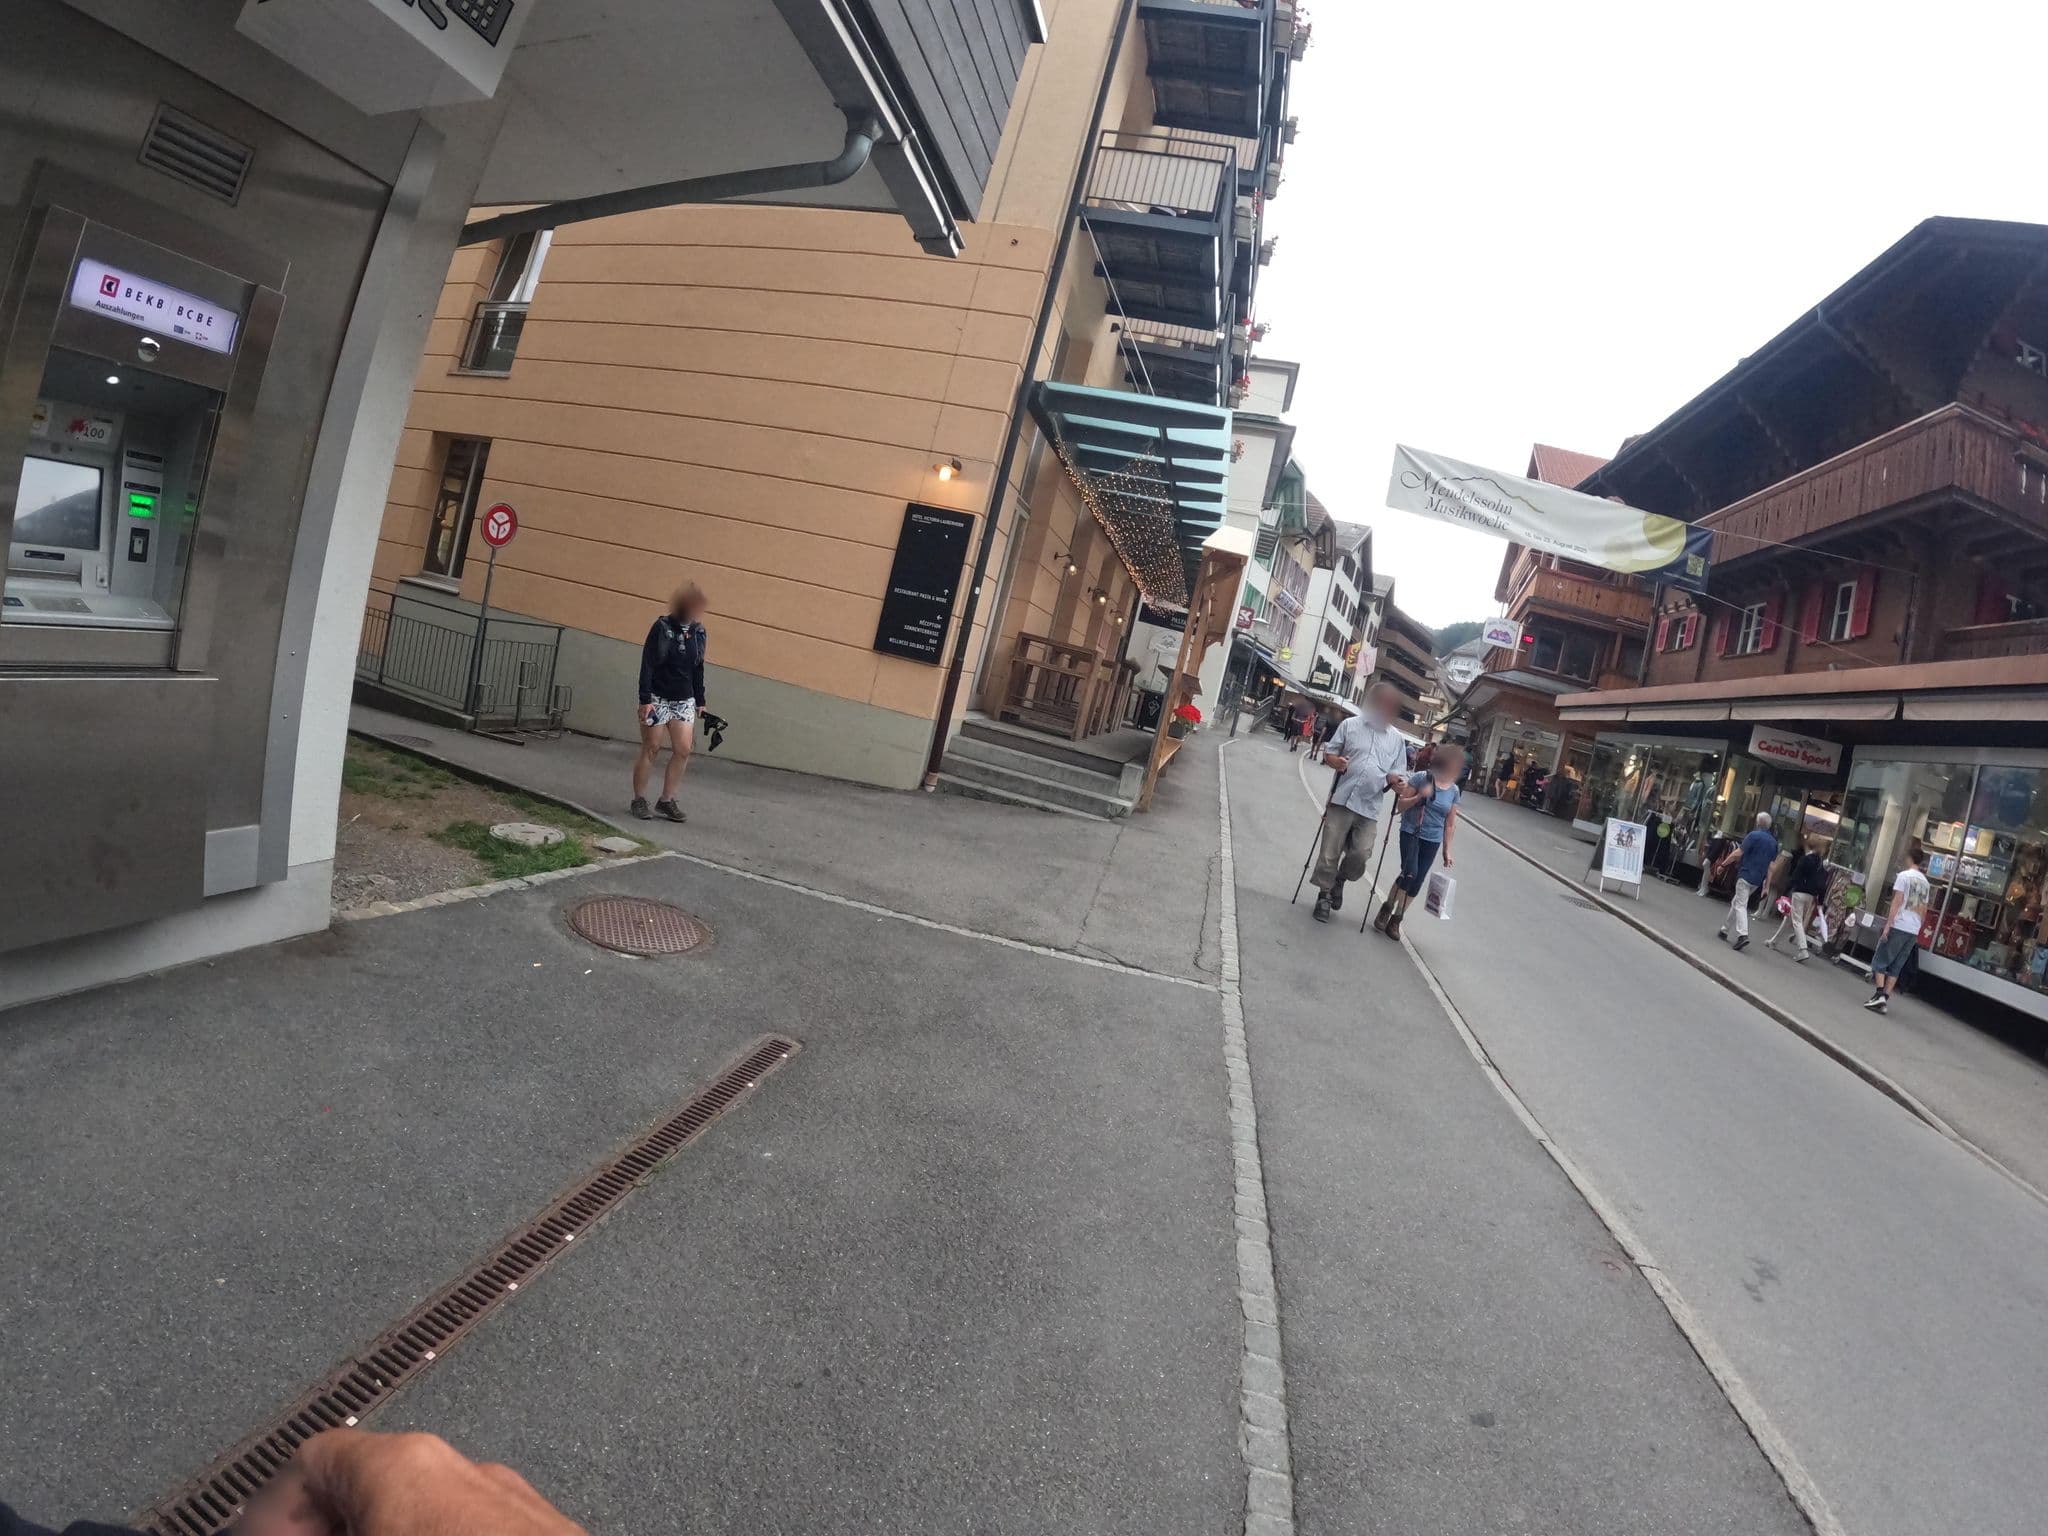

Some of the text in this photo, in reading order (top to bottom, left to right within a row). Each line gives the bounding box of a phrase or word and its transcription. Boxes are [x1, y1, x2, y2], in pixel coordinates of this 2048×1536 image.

[96, 299, 145, 322] Auszahlungen
[125, 287, 214, 327] BEKB BCBE
[1400, 470, 1513, 516] Mendelssohn
[1425, 496, 1510, 531] Musikwoche
[1758, 740, 1832, 767] Central Sport
